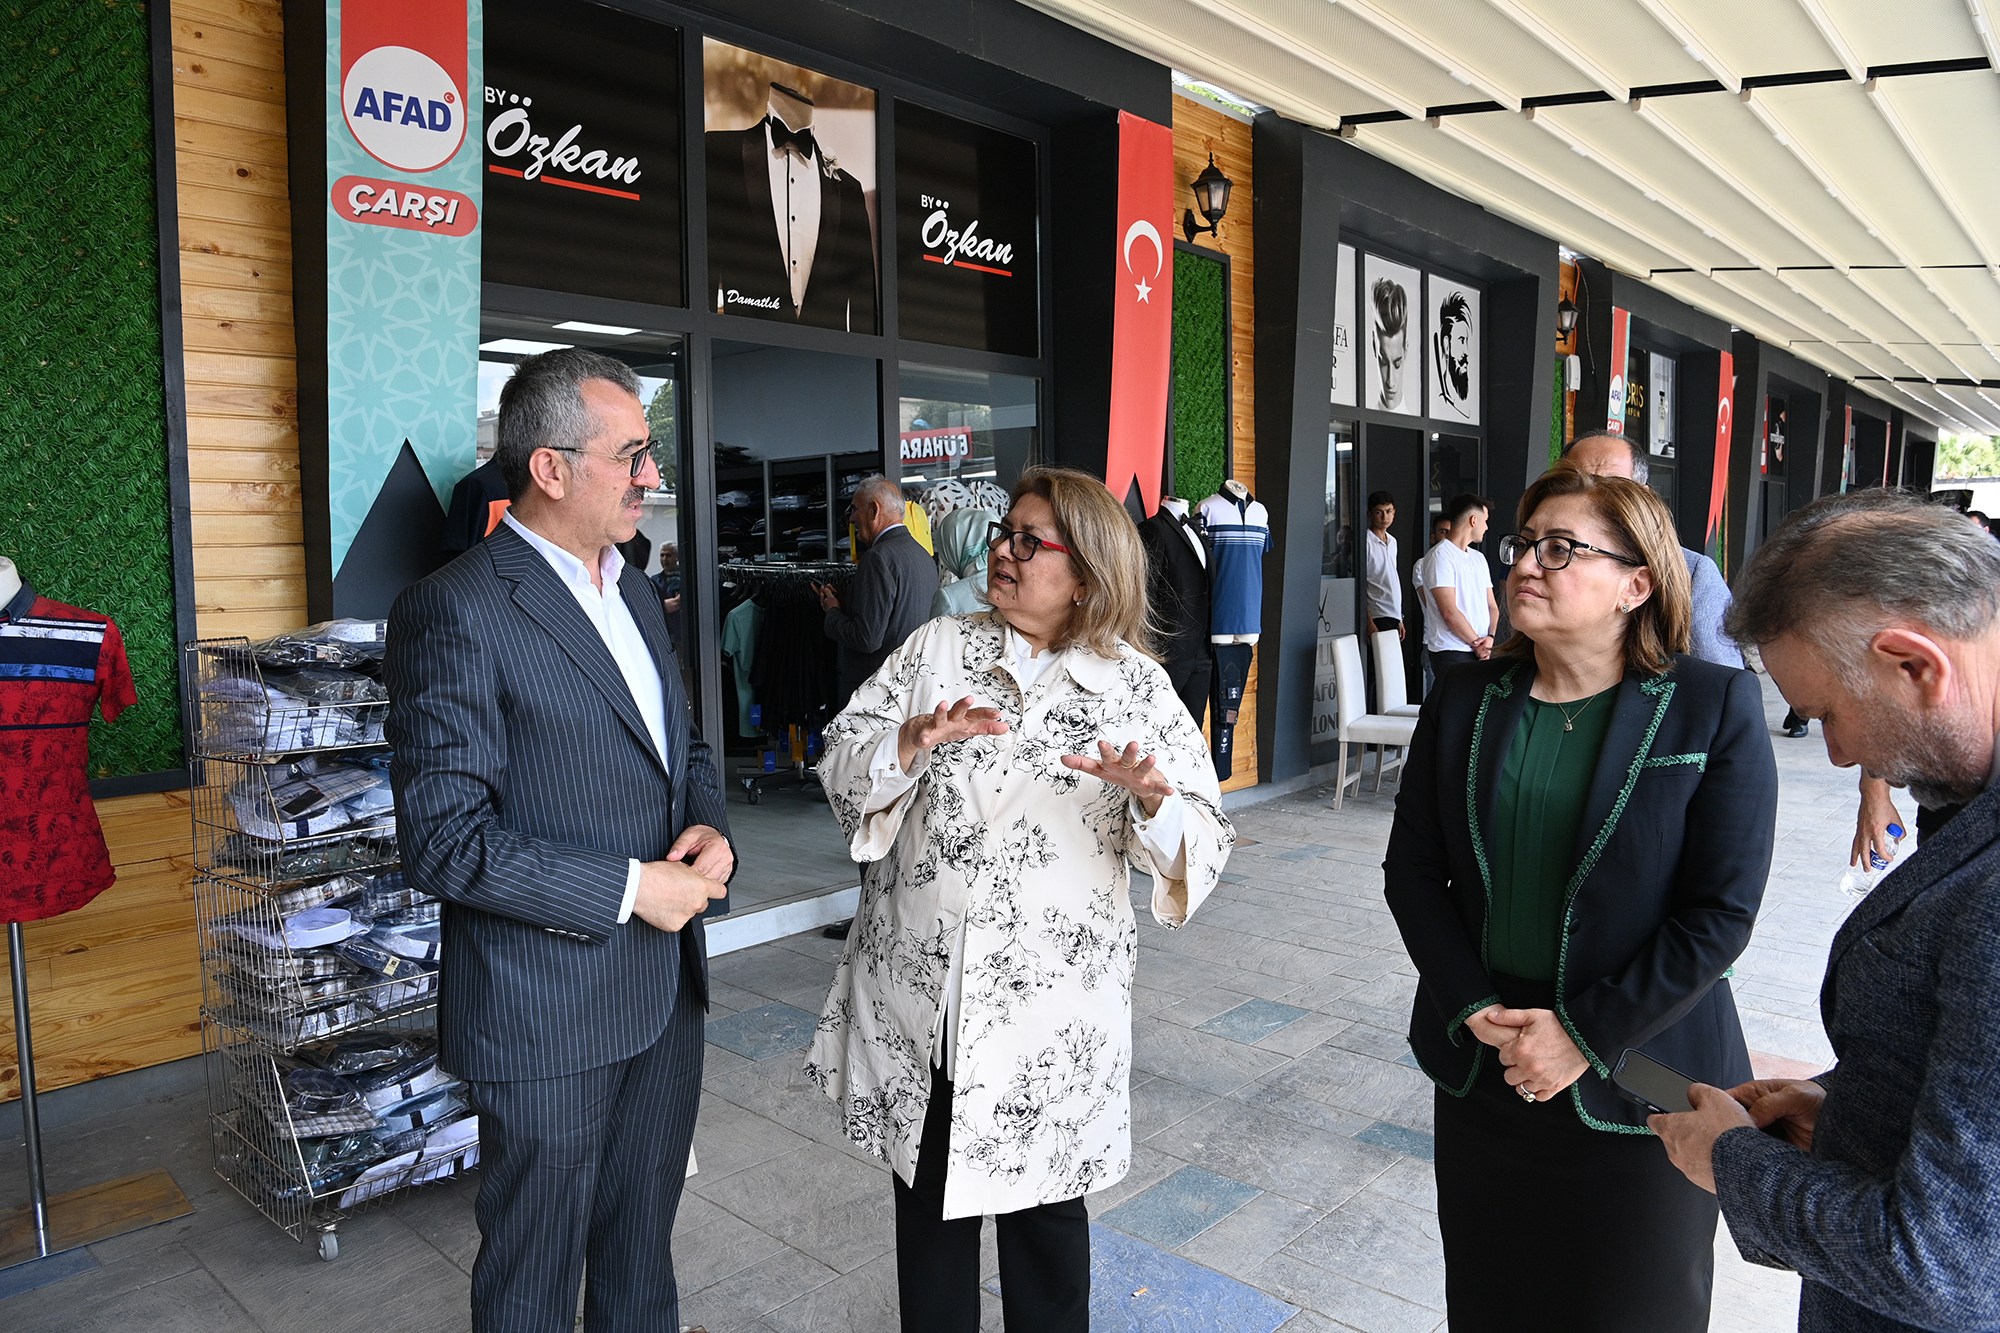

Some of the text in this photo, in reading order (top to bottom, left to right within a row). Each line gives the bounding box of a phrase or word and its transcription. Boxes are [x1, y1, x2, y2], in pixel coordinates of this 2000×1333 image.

[353, 87, 452, 133] AFAD
[485, 86, 506, 106] BY
[486, 93, 642, 185] Özkan
[348, 184, 459, 228] ÇARŞI
[921, 194, 934, 209] BY
[921, 199, 1014, 265] Özkan
[726, 289, 780, 310] Damatlık
[1314, 678, 1337, 703] AFÖ
